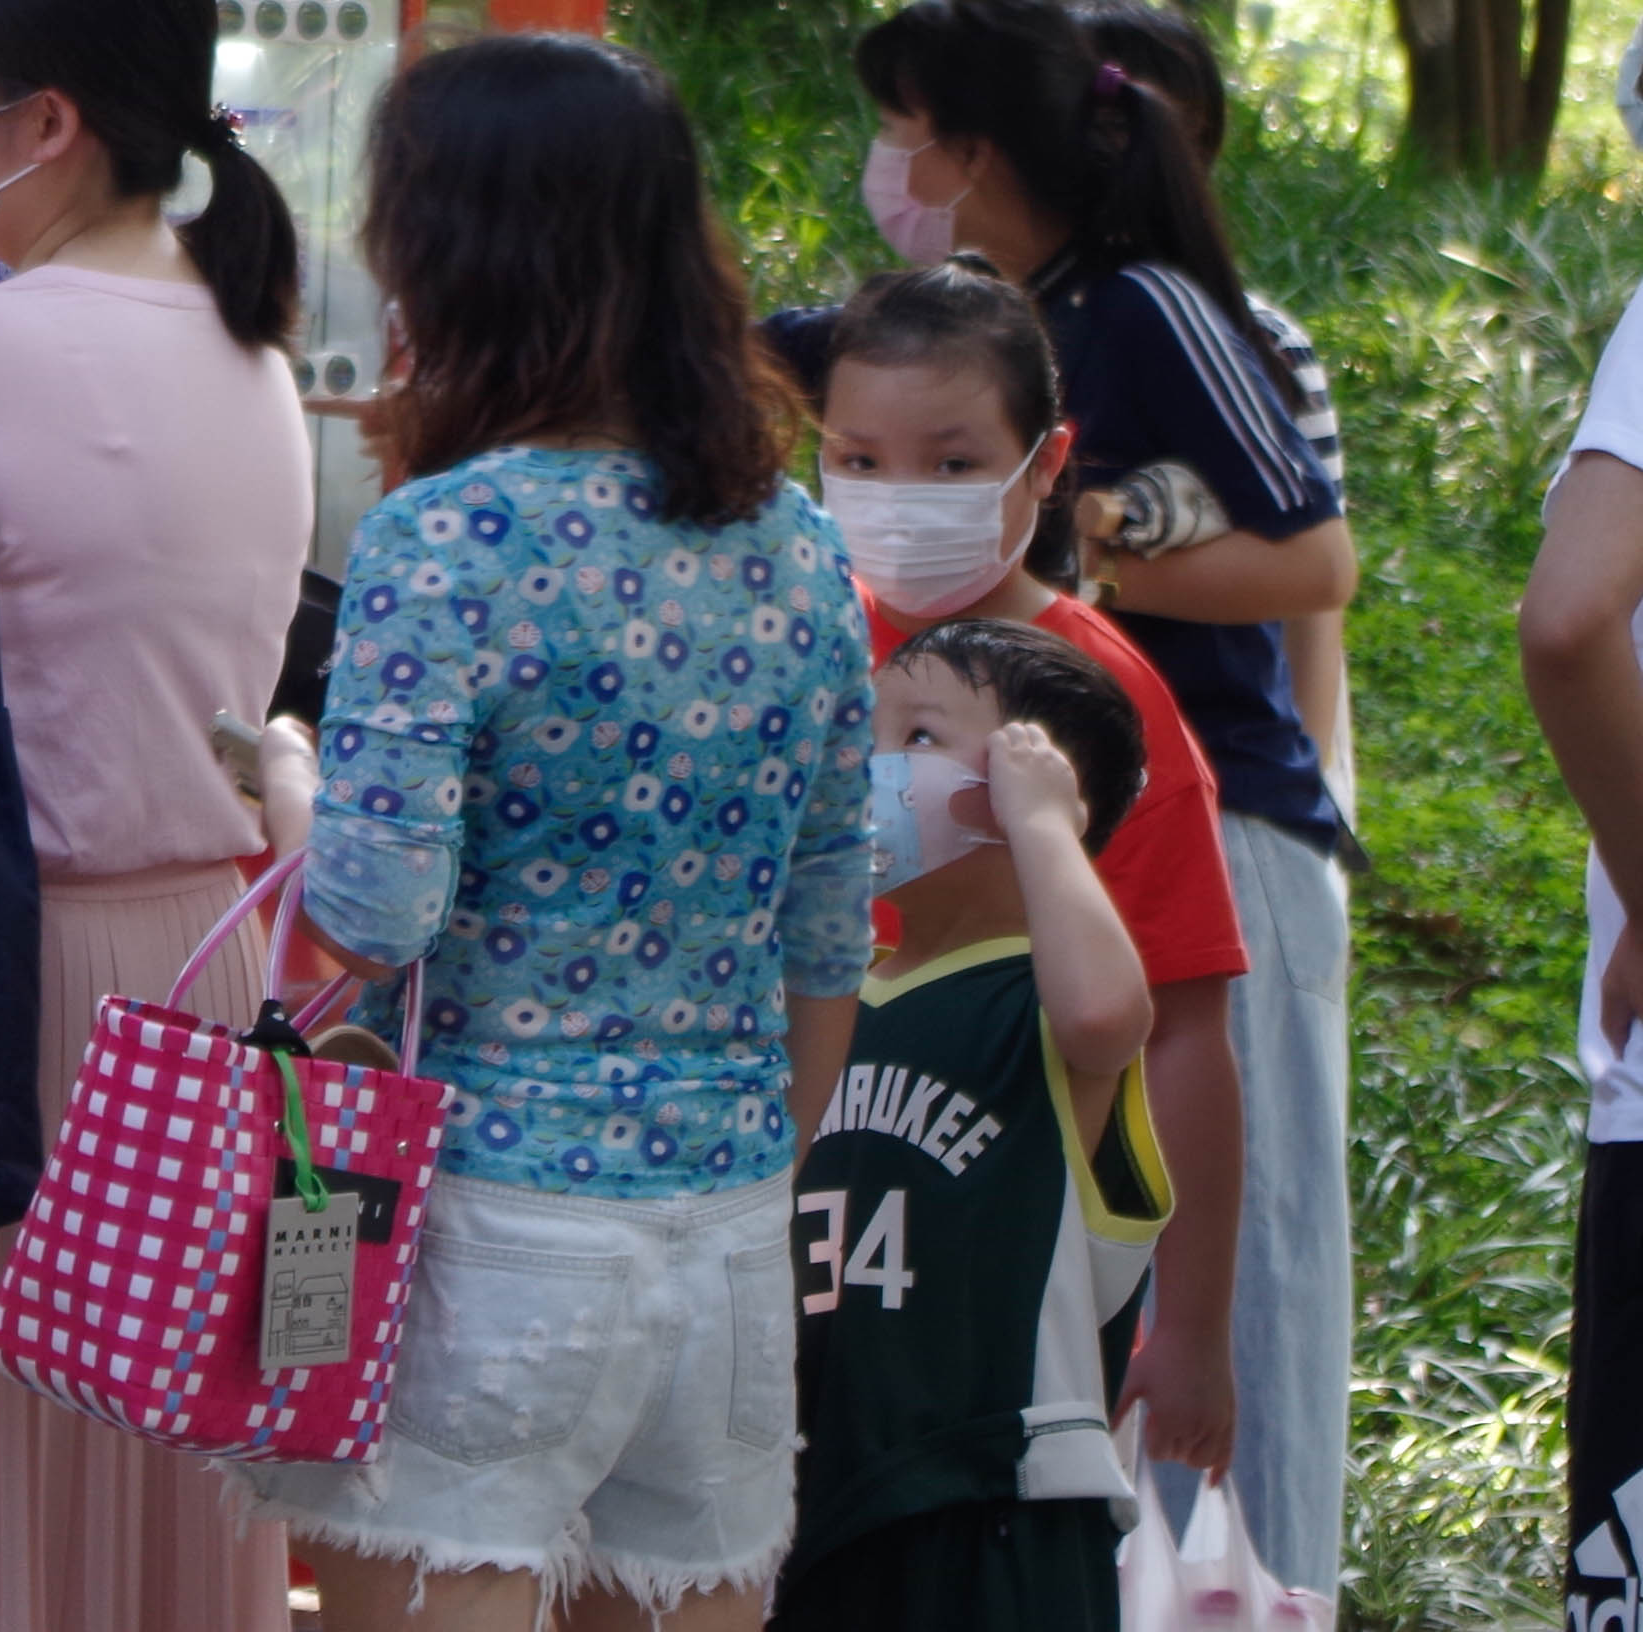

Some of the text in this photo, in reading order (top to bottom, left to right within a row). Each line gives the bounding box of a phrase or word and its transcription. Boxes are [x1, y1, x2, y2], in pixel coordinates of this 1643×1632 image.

[275, 1223, 352, 1243] MARNI
[274, 1241, 351, 1257] MARKET
[797, 1189, 914, 1315] 34
